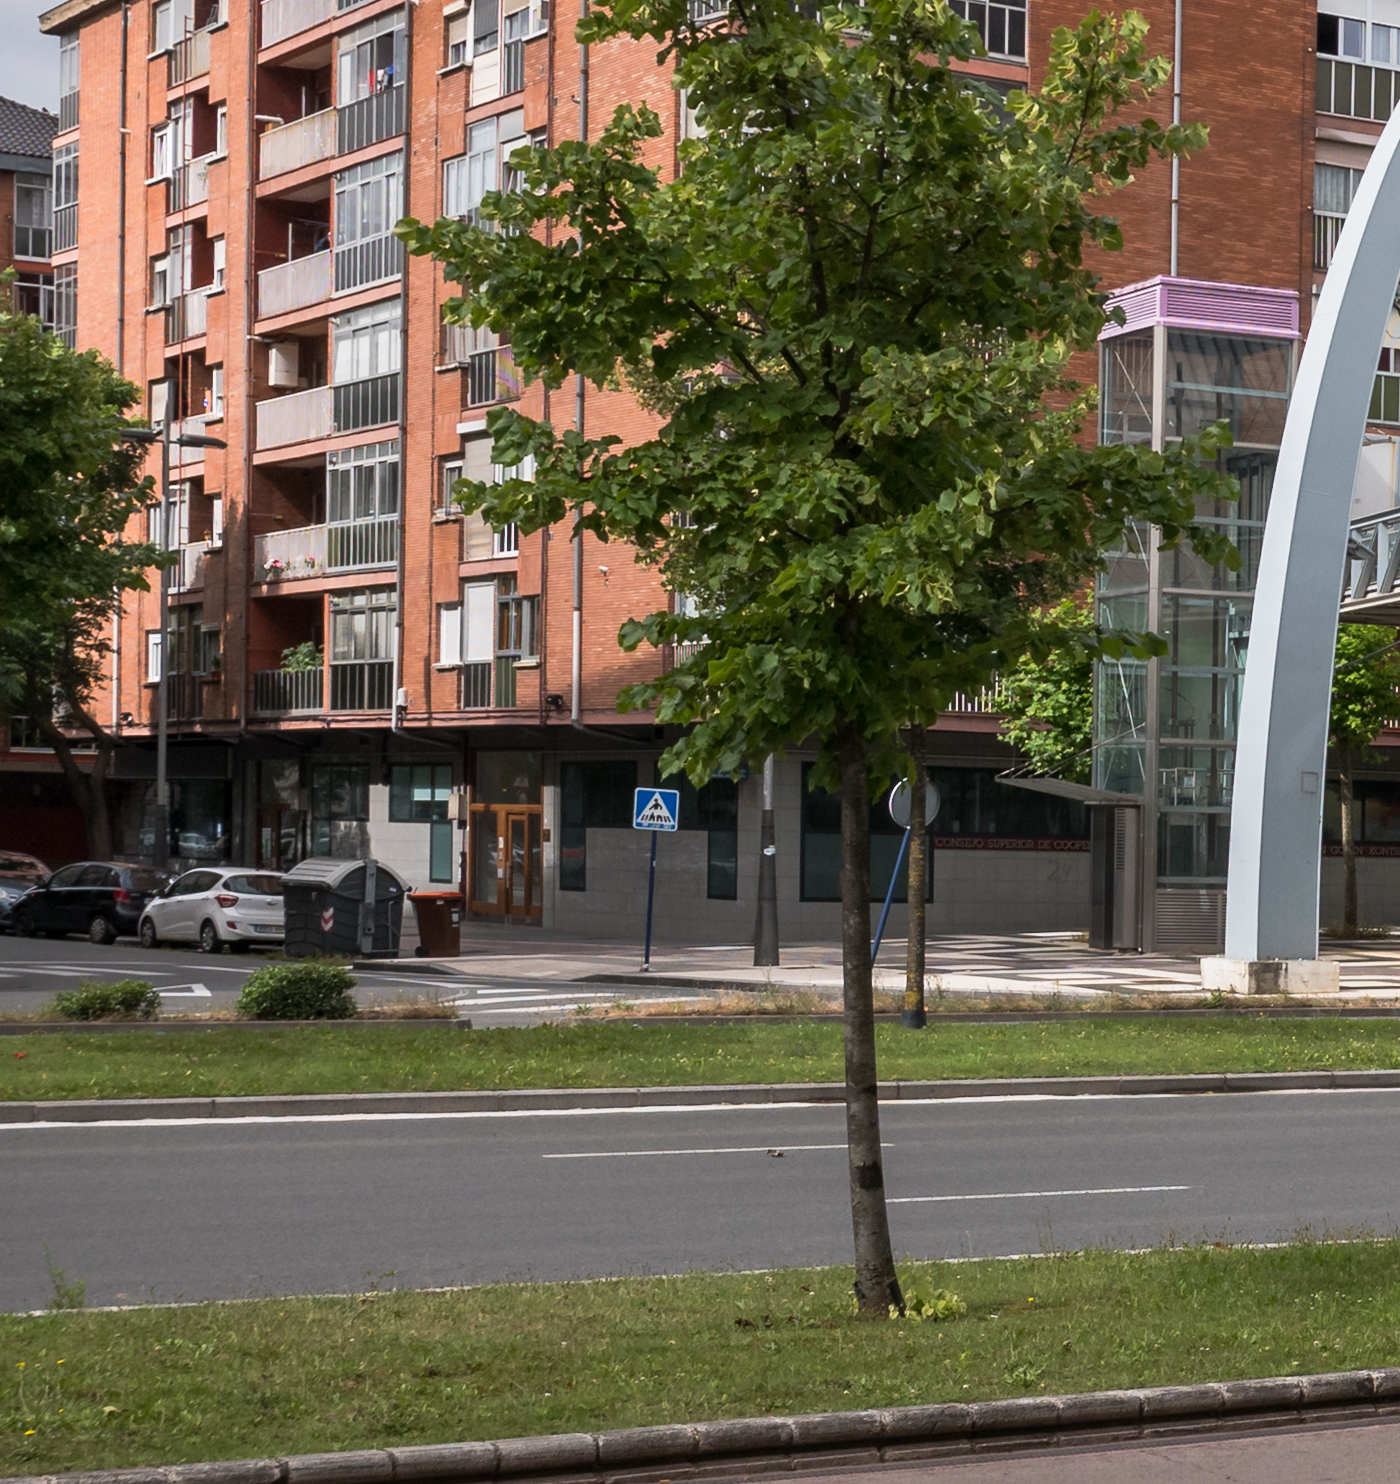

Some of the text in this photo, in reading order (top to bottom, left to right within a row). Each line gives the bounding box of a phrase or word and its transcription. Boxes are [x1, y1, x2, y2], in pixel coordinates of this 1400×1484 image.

[935, 837, 1090, 850] CONSEJO SUPERIOR DE COOPE
